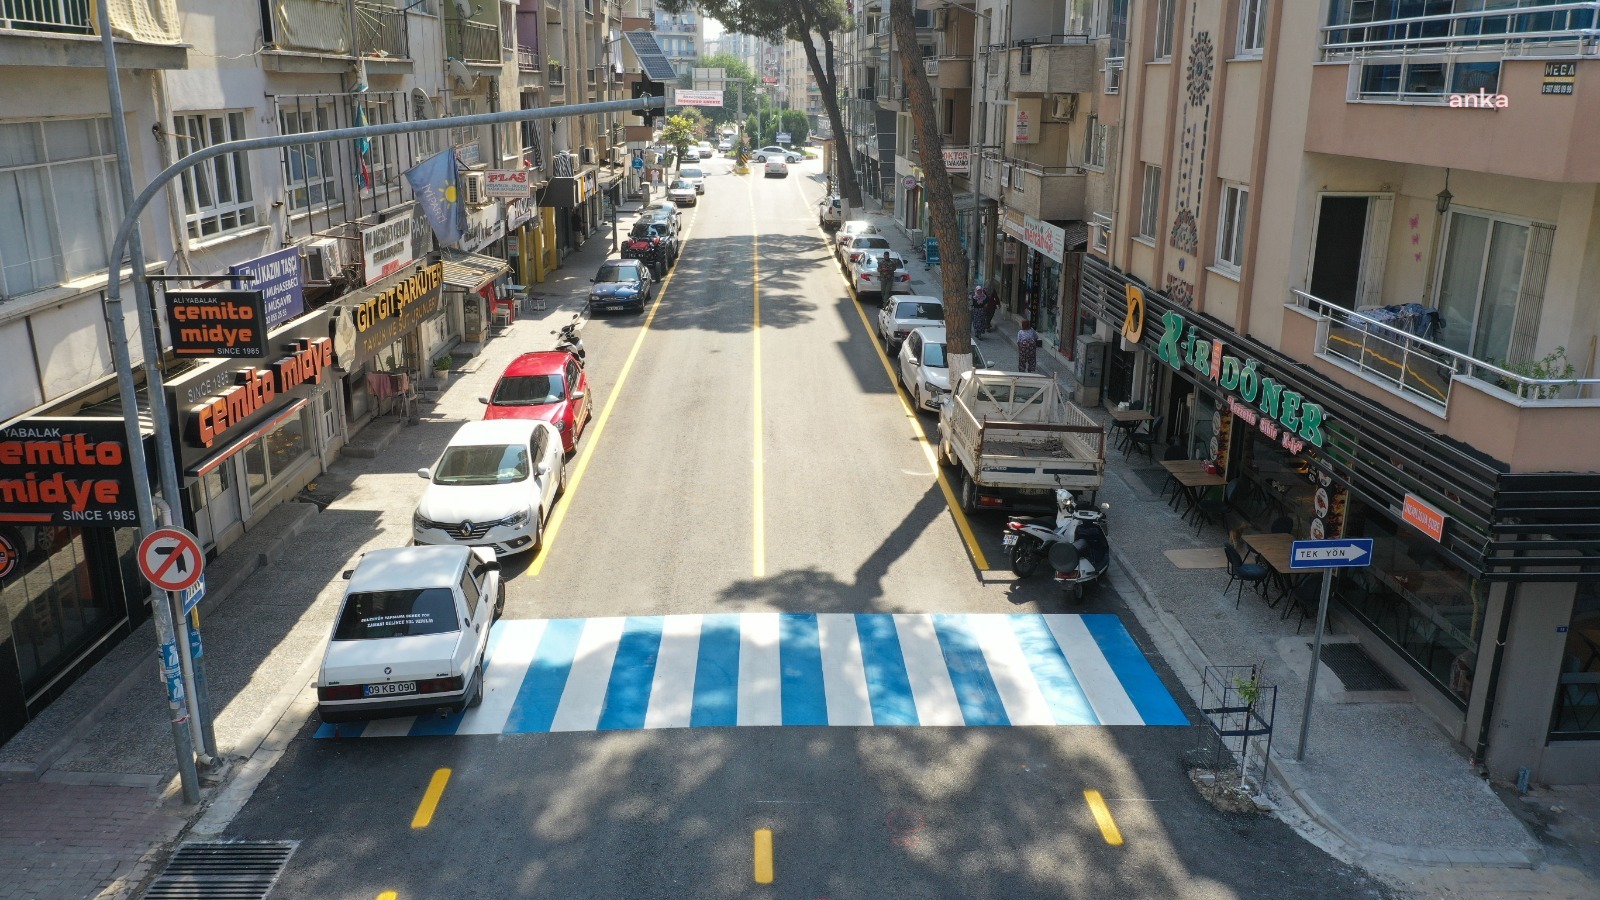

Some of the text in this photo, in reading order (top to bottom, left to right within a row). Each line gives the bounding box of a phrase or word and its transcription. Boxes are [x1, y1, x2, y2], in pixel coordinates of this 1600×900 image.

[1545, 64, 1575, 76] MEGA
[943, 151, 968, 160] OKTOR
[251, 263, 262, 288] ALİ
[262, 260, 281, 284] KAZIM
[173, 296, 184, 304] ALİ
[268, 292, 292, 312] MÜŞAVİR
[173, 301, 254, 323] çemito
[180, 324, 252, 347] midye
[187, 370, 229, 403] SINCE 1985
[199, 336, 332, 448] çemito midye
[1220, 355, 1324, 448] DÖNER
[3, 427, 62, 438] YABALAK
[0, 433, 123, 466] emito
[0, 472, 120, 512] midye
[62, 510, 136, 521] SINCE 1985
[1301, 548, 1346, 558] TEK YÖN
[368, 683, 415, 695] 09 KB 090
